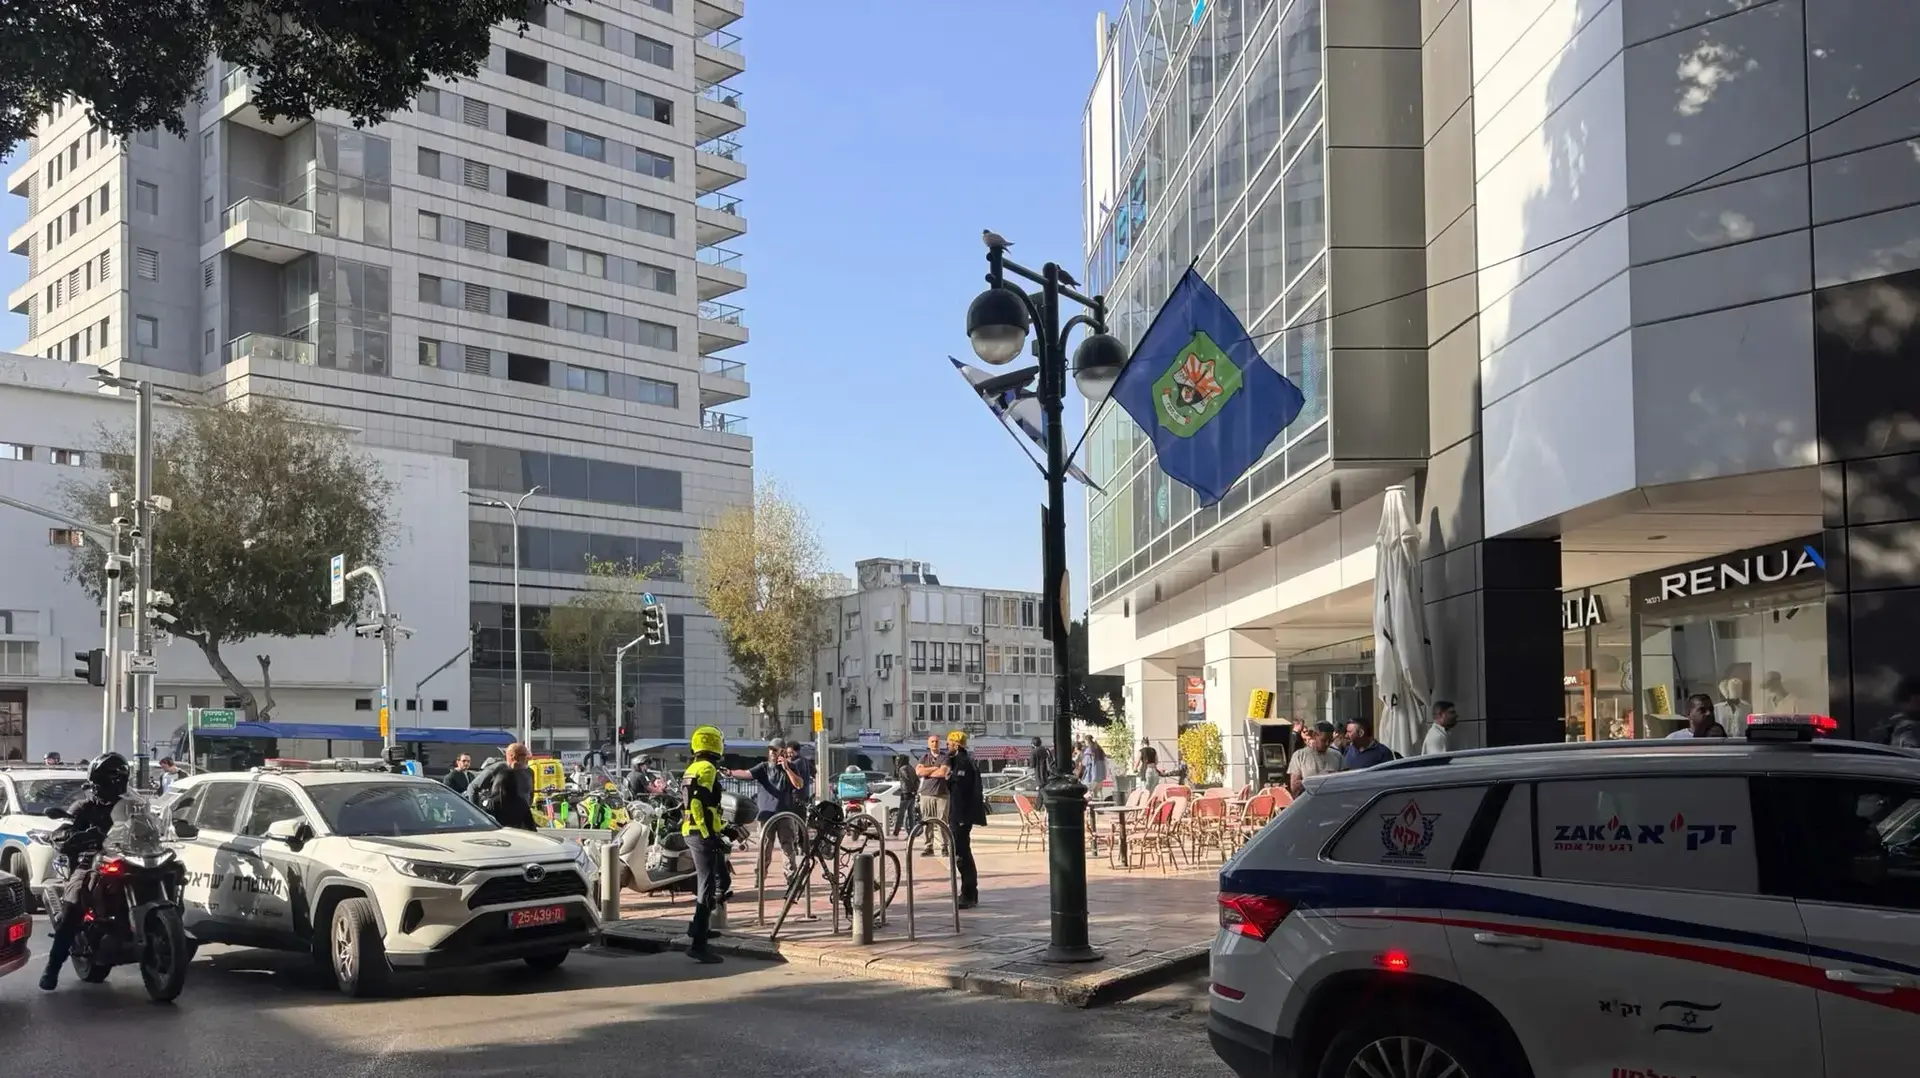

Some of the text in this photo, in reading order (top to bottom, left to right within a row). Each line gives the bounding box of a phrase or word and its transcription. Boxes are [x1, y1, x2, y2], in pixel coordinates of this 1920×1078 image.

[1661, 546, 1825, 600] RENUA
[1562, 594, 1601, 630] LIA
[1554, 842, 1633, 852] רגע של אמת
[232, 876, 283, 896] משטרת
